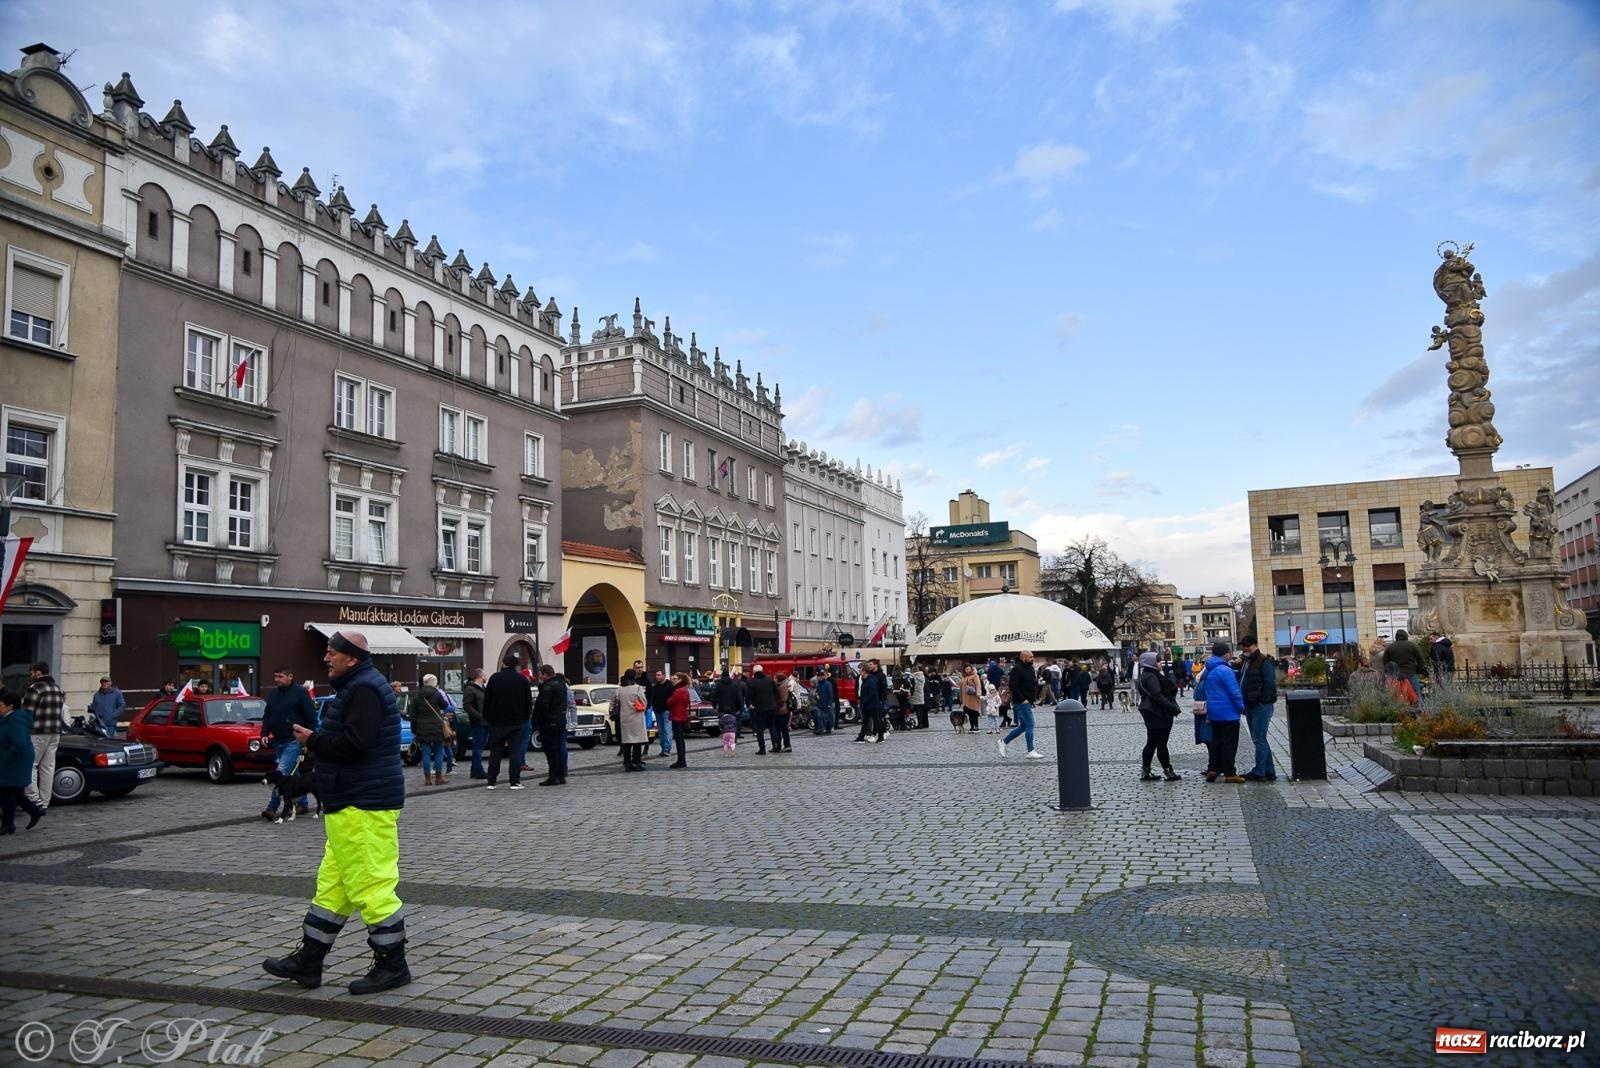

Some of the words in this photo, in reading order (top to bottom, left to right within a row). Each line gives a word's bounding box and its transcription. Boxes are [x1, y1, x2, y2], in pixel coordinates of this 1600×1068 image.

[949, 529, 990, 539] McDonald's
[339, 605, 398, 624] Manufaktura
[399, 609, 429, 626] Lodów
[430, 609, 465, 627] Gałeczka
[656, 610, 714, 630] APTEKA
[202, 629, 251, 649] abka
